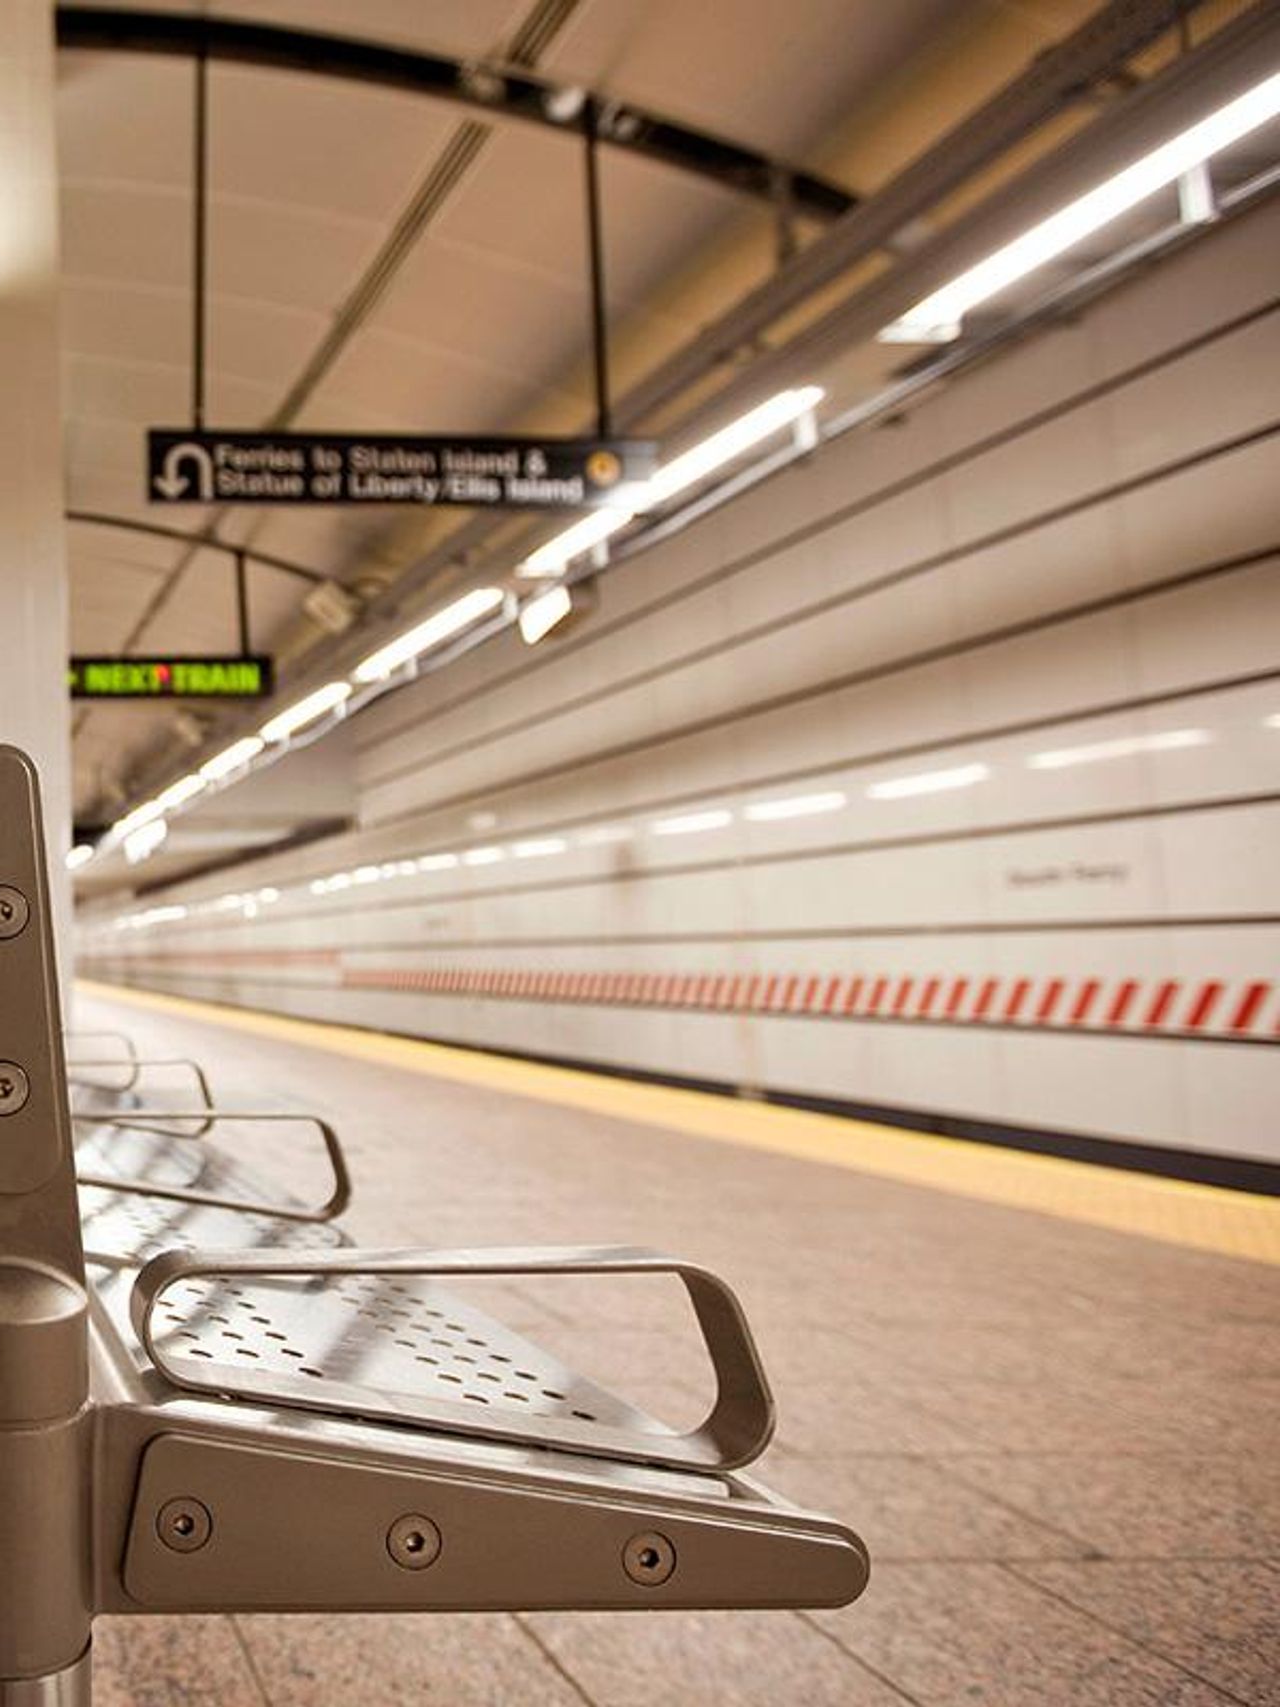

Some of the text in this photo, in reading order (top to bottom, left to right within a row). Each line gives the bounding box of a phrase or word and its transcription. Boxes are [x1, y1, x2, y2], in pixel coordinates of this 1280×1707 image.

[216, 445, 548, 476] Ferries to Staten Island &
[218, 469, 304, 496] Statue
[311, 472, 341, 498] of
[507, 475, 584, 502] Island
[86, 663, 261, 693] NEXT TRAIN
